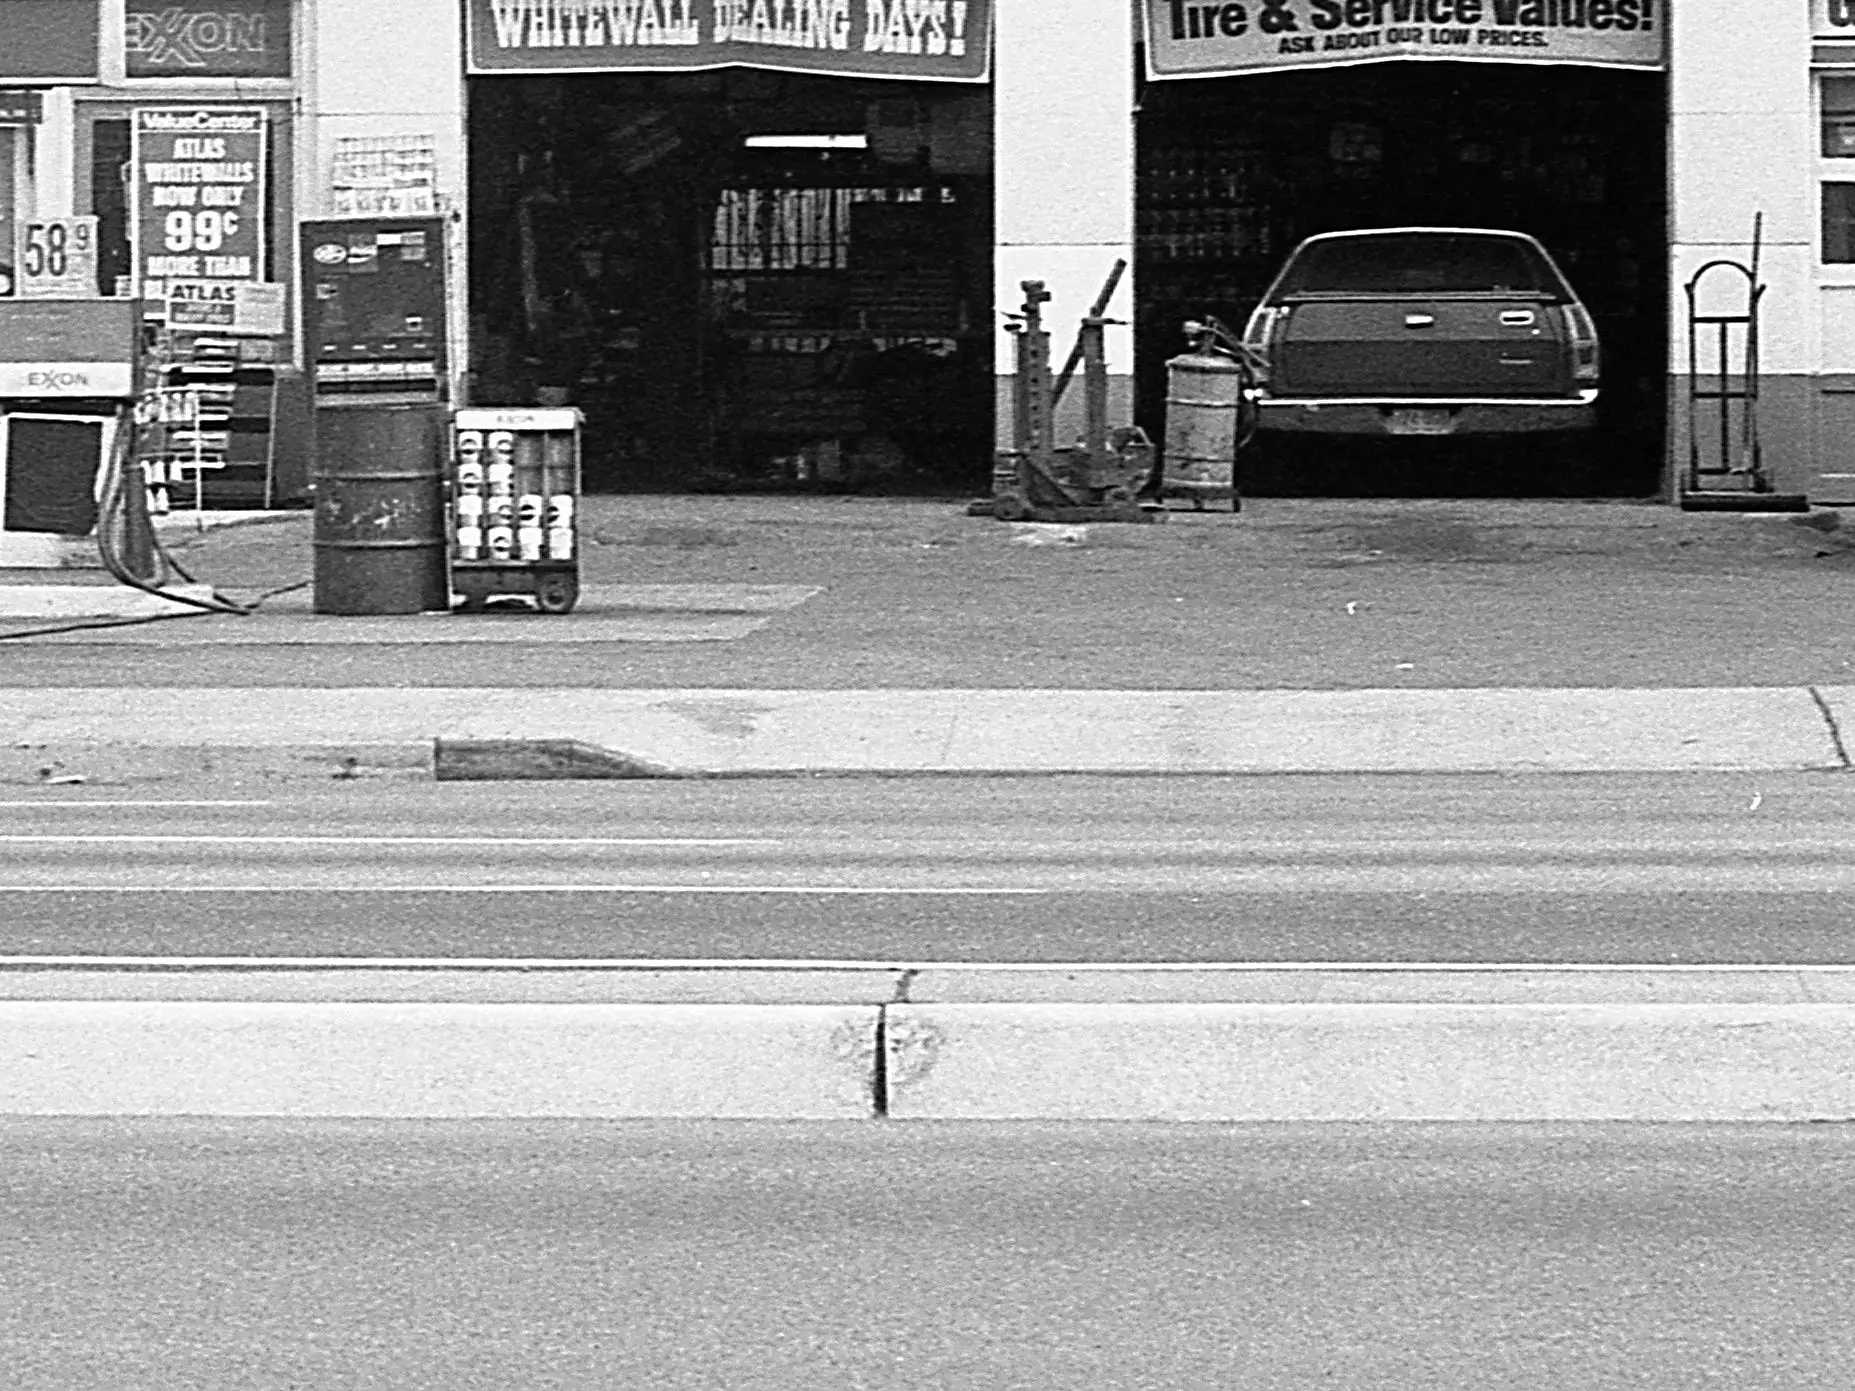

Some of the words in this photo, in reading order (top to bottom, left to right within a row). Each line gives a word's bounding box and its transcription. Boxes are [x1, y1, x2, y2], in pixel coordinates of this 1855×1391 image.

[1277, 33, 1316, 55] ASK
[1322, 30, 1380, 52] ABOUT
[1386, 27, 1424, 46] OUR
[1429, 27, 1471, 46] LOW
[1476, 28, 1550, 48] PRICES.
[172, 137, 227, 159] ATLAS
[144, 161, 255, 184] WHITEWALLS
[152, 185, 197, 207] NOW
[201, 185, 245, 207] ONLY
[24, 223, 67, 278] 58
[147, 256, 200, 277] MORE
[204, 256, 251, 277] THAN
[171, 284, 237, 301] ATLAS
[27, 369, 89, 391] EXXON
